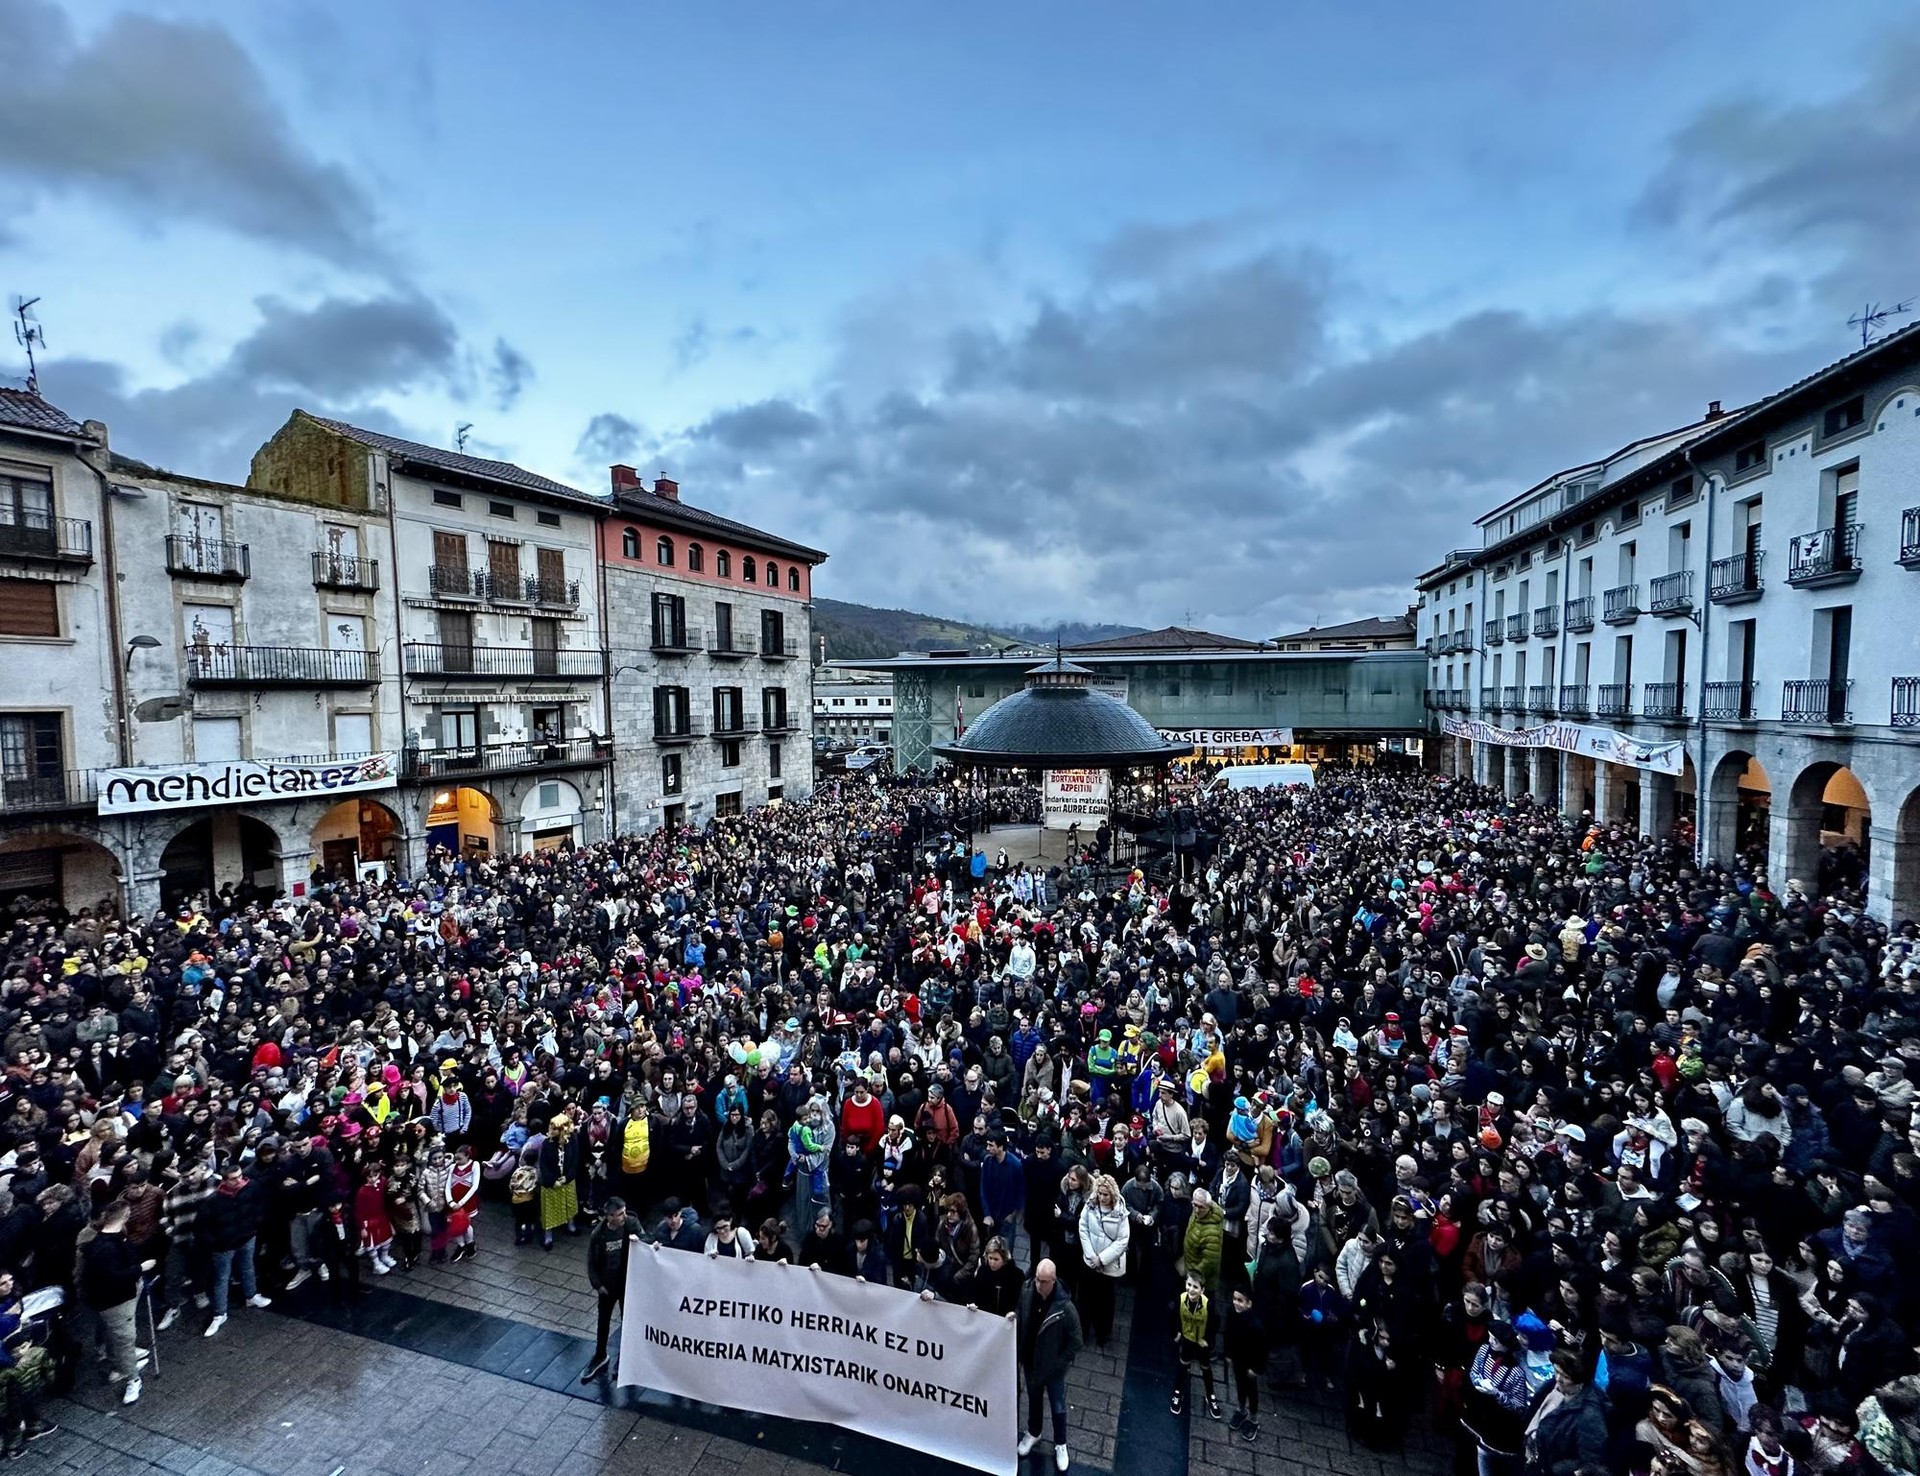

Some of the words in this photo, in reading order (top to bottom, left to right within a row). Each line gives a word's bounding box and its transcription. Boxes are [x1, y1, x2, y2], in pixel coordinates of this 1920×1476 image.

[1159, 731, 1208, 744] KASLE
[1212, 730, 1264, 743] GREBA
[107, 765, 318, 805] mendietan
[321, 764, 360, 789] ez
[1051, 775, 1084, 783] BORTXATU
[1063, 804, 1087, 813] AURRE
[678, 1296, 783, 1325] AZPEITIKO
[790, 1310, 878, 1345] HERRIAK
[885, 1332, 909, 1354] EZ
[916, 1339, 944, 1361] DU
[645, 1324, 747, 1362] INDARKERIA
[752, 1346, 878, 1387] MATXISTARIK
[883, 1373, 988, 1418] ONARTZEN
